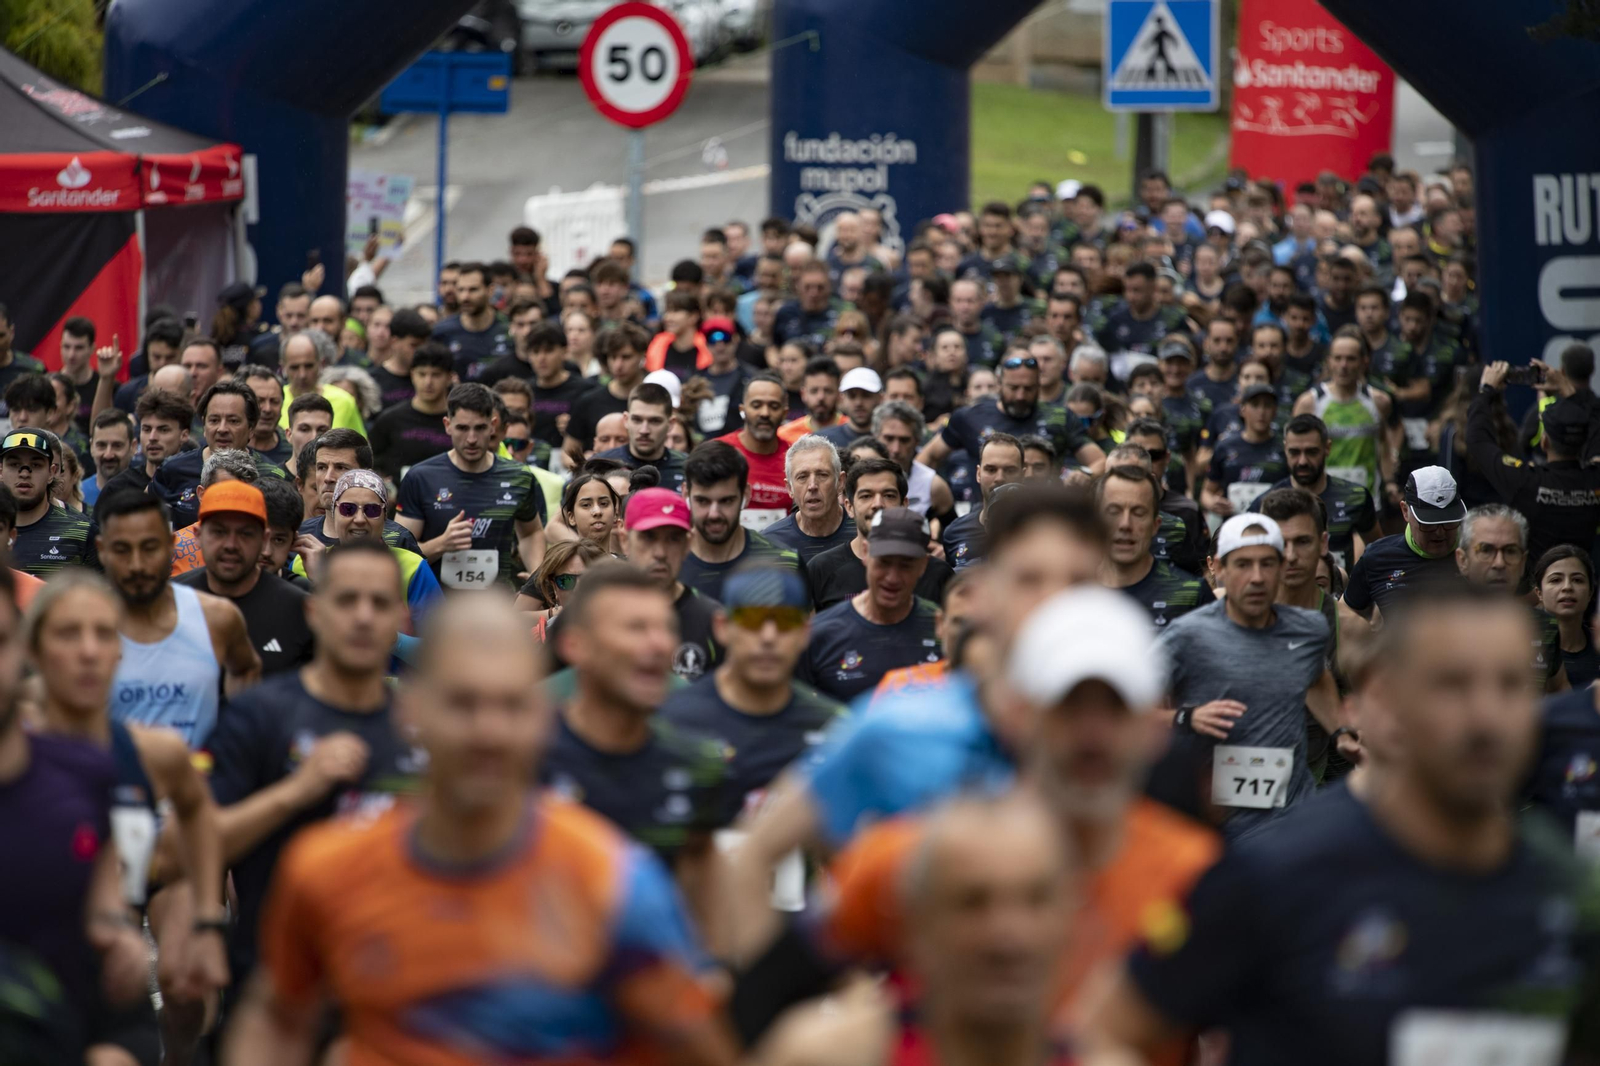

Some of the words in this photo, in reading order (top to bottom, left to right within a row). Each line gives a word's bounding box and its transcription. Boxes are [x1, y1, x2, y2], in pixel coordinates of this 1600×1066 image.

[1259, 20, 1344, 56] Sports
[607, 45, 667, 82] 50
[1251, 58, 1381, 94] Santander
[784, 131, 917, 164] fundación
[801, 165, 888, 196] mupol
[27, 187, 121, 207] Santander
[455, 570, 485, 582] 154
[1233, 777, 1276, 796] 717
